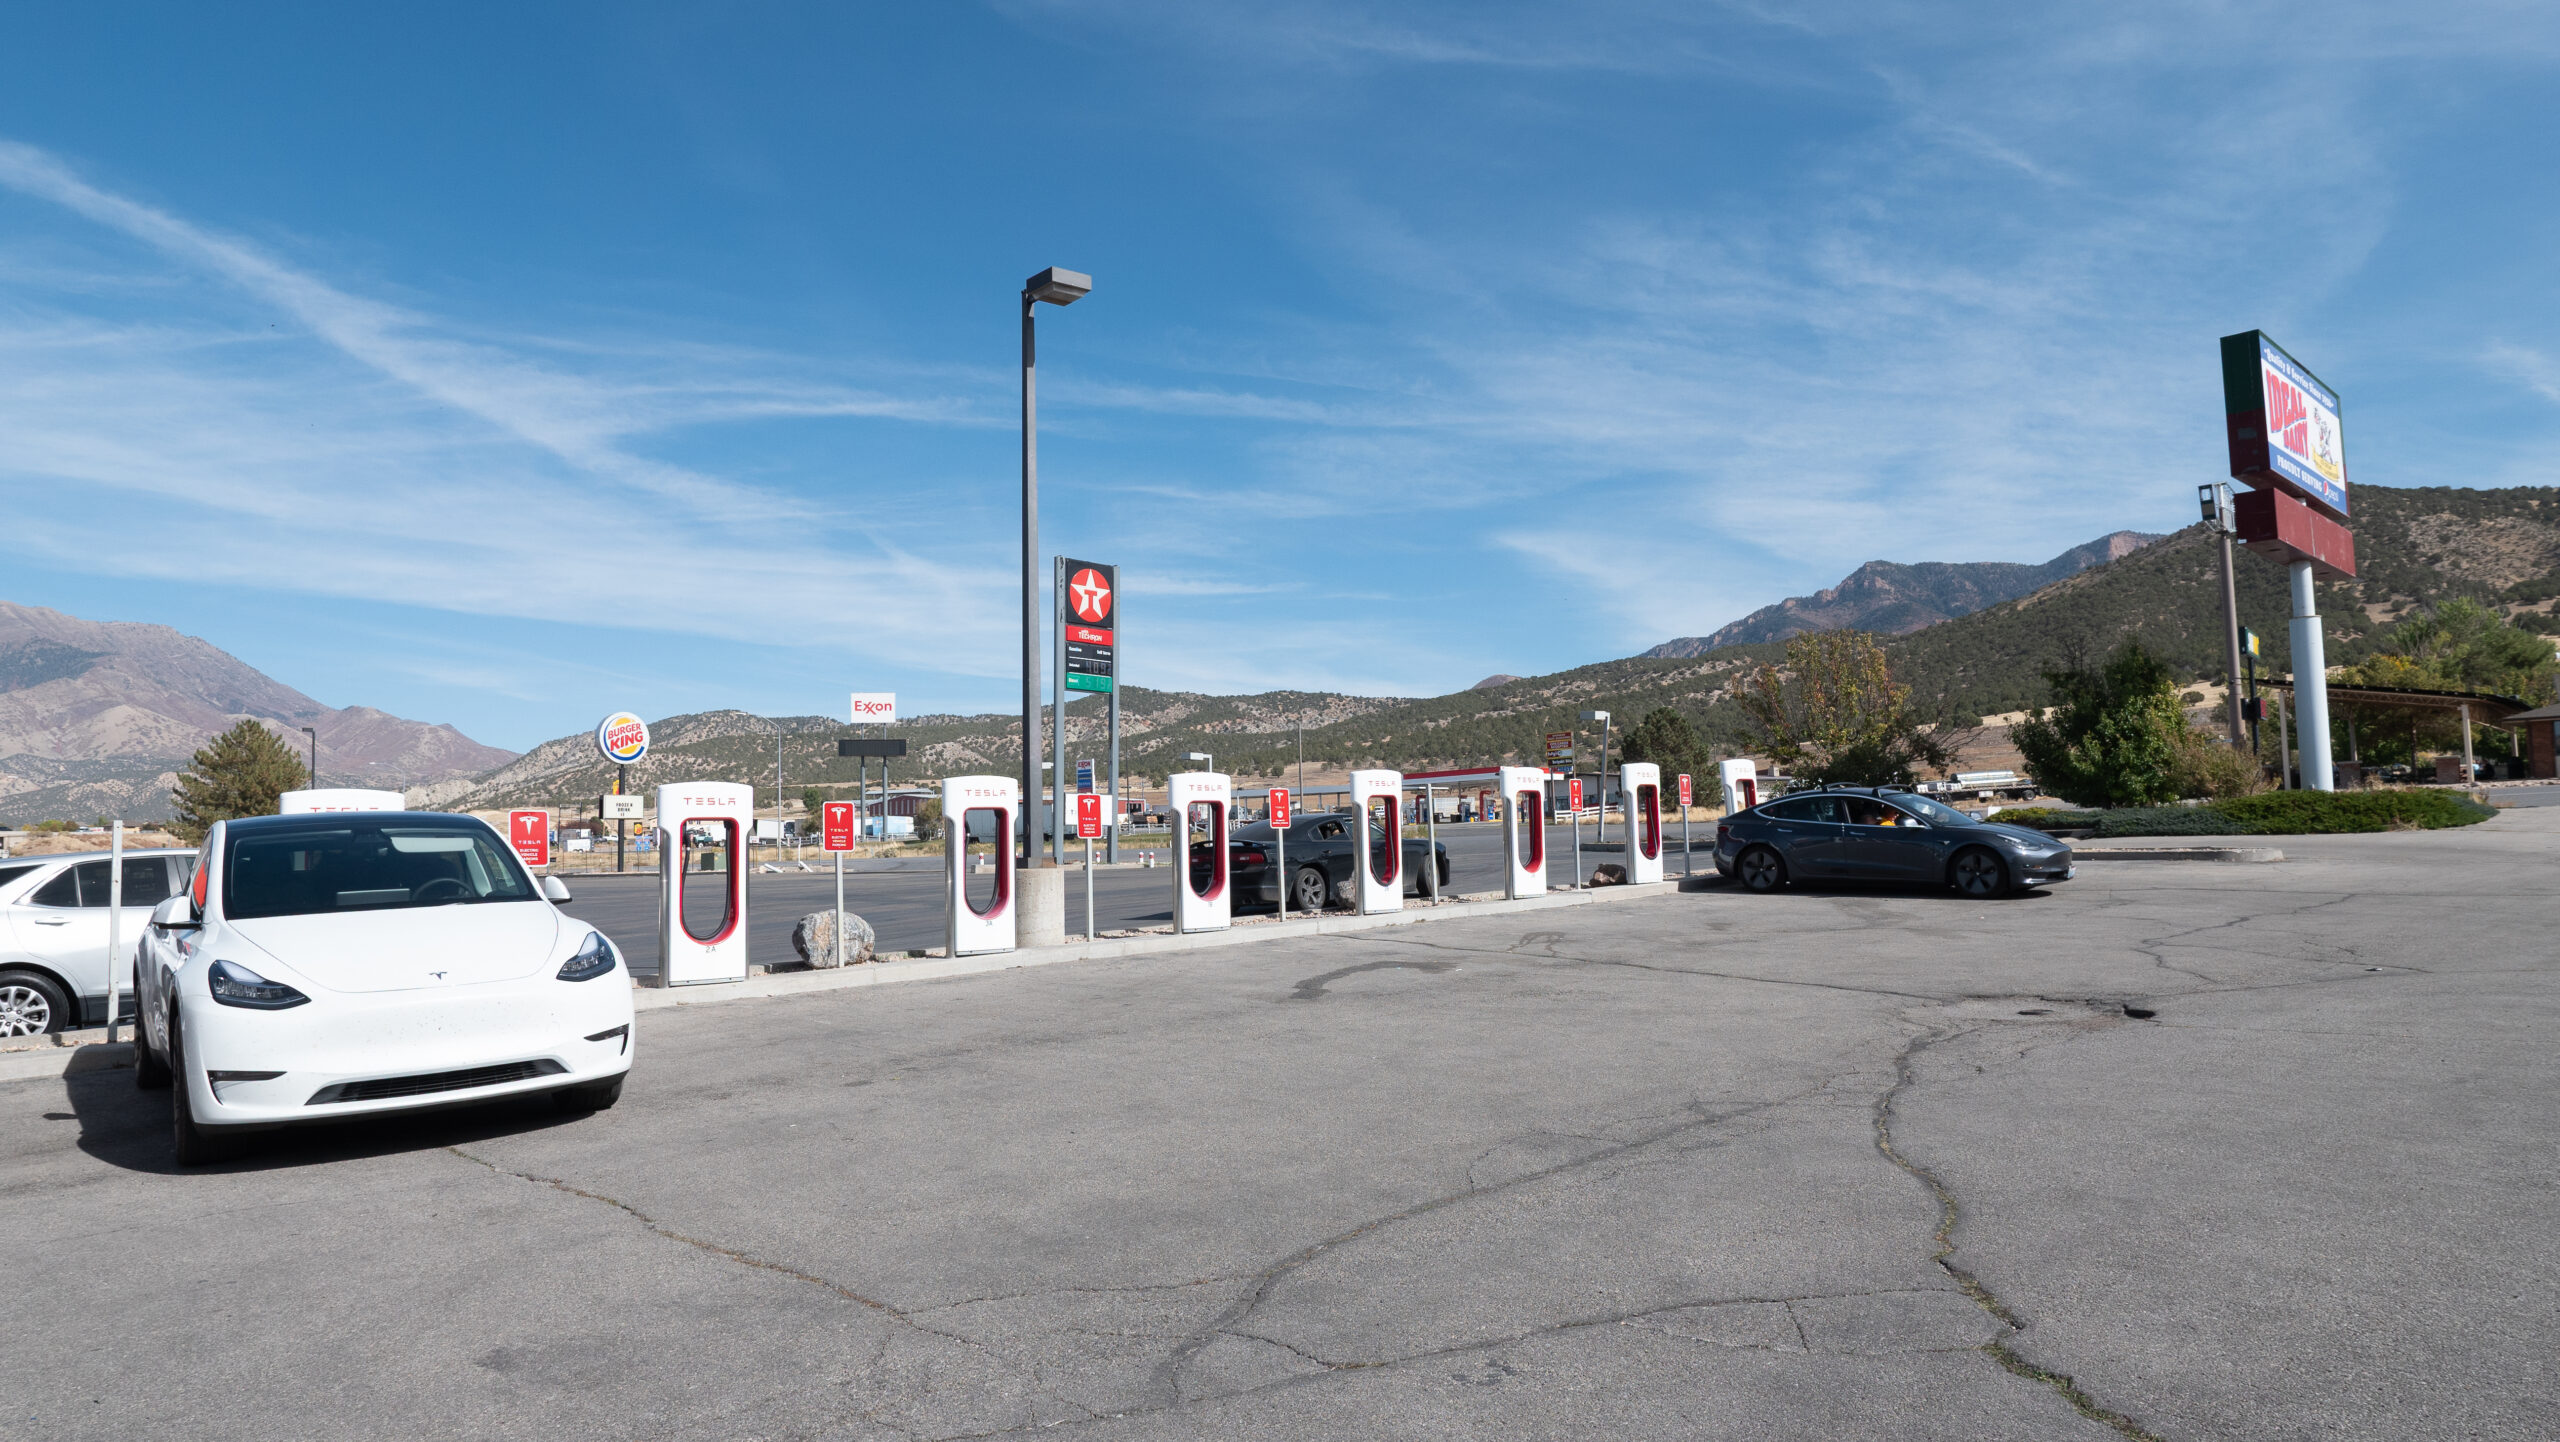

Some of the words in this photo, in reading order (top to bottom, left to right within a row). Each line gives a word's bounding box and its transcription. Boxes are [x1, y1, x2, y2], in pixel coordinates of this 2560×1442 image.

[2266, 368, 2307, 434] IDEAL
[2282, 420, 2309, 460] DAIRY
[2277, 454, 2301, 479] PROUDLY
[2301, 470, 2323, 493] SERVING
[854, 700, 893, 715] Exxon
[607, 723, 641, 740] BURGER
[610, 731, 644, 752] KING
[965, 789, 1006, 797] TESLA
[1189, 784, 1223, 792] TESLA
[683, 797, 736, 806] TESLA
